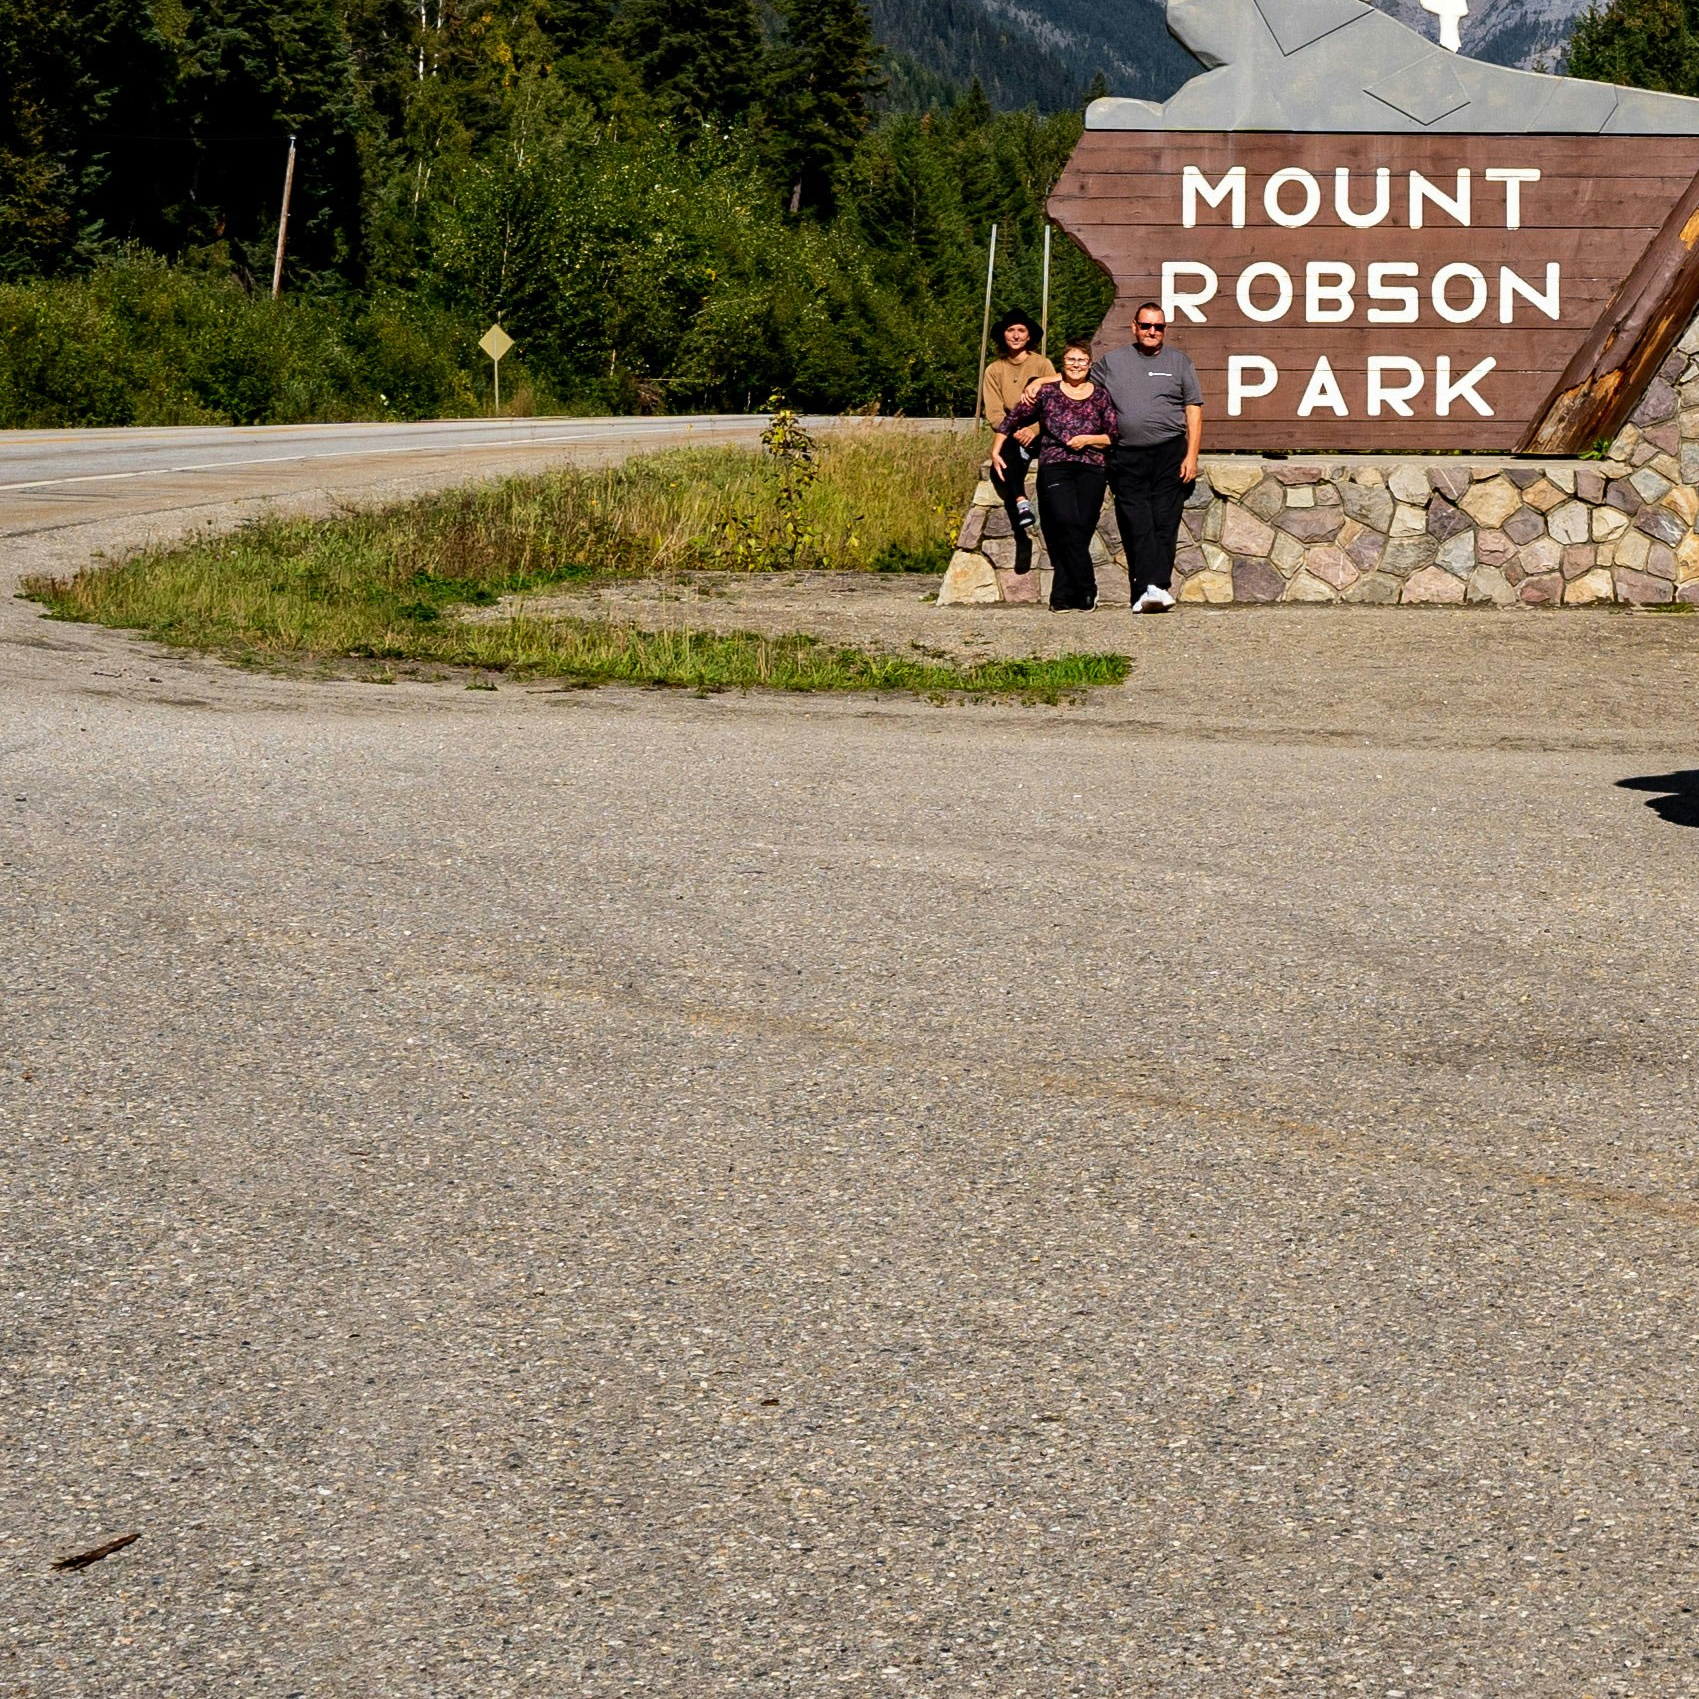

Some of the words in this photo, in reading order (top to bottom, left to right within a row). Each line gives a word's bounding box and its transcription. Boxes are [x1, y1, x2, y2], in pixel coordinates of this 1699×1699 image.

[1182, 165, 1541, 230] MOUNT
[1161, 261, 1561, 324] ROBSON
[1227, 355, 1497, 417] PARK
